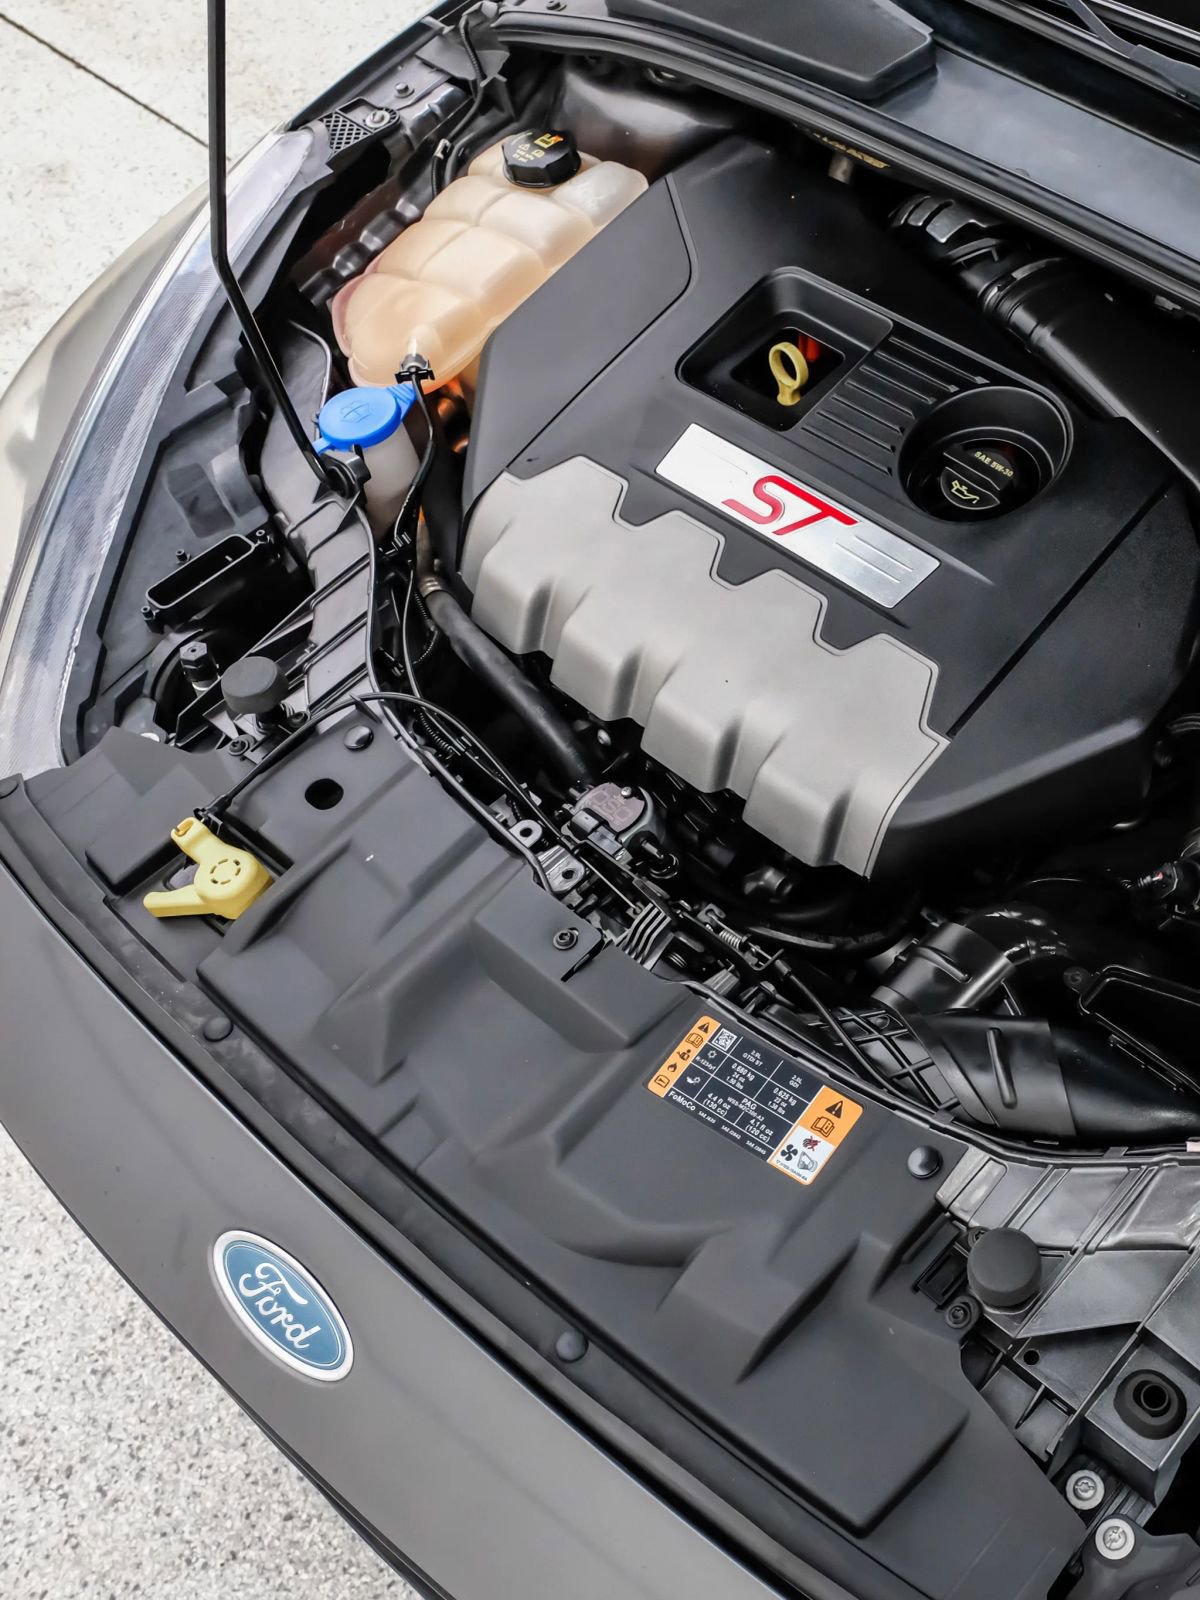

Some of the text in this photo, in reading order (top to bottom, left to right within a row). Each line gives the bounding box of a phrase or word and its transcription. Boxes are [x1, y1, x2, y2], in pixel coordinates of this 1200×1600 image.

[974, 451, 1014, 477] SAE 5W-30
[721, 475, 858, 536] ST
[746, 1072, 755, 1081] kg
[789, 1080, 799, 1088] GDI
[668, 1090, 696, 1111] FoMoCo
[708, 1093, 718, 1101] 4.4
[741, 1098, 757, 1110] PAG
[788, 1096, 797, 1106] kg
[702, 1098, 727, 1117] (130 cc)
[750, 1119, 760, 1127] 4.1
[745, 1124, 770, 1143] (120 cc)
[239, 1262, 322, 1348] Ford
